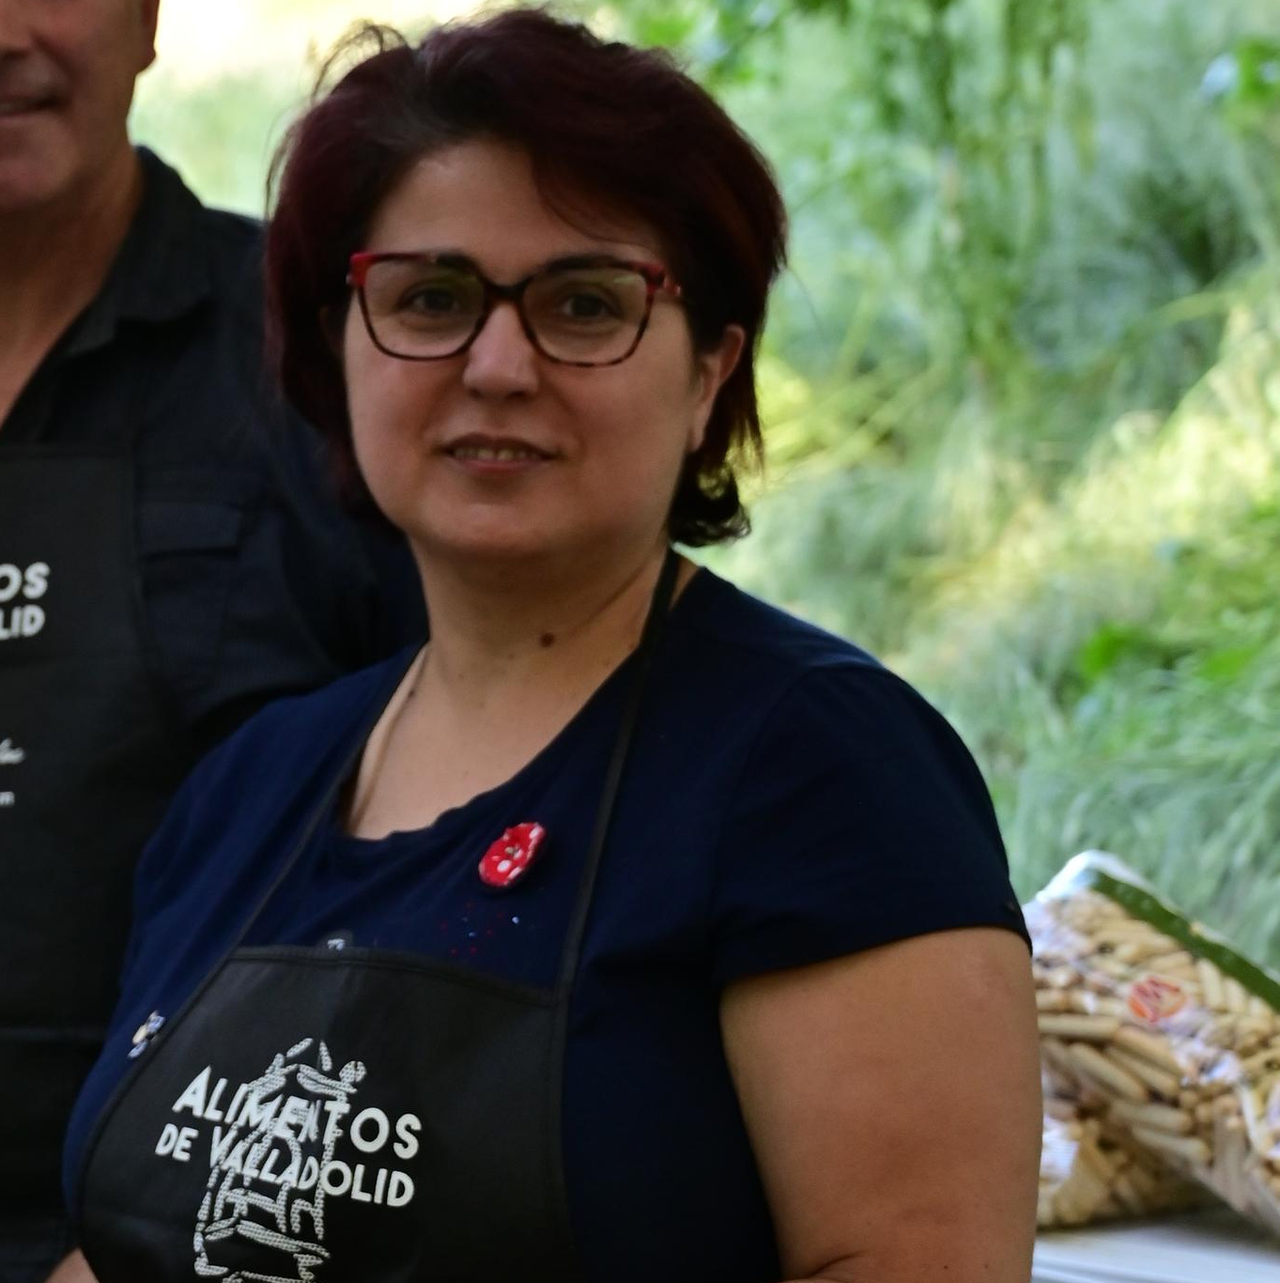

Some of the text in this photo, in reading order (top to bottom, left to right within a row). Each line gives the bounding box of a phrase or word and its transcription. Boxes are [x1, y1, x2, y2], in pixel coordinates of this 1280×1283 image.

[172, 1065, 422, 1160] ALIMENTOS
[155, 1123, 416, 1208] DE VALLADOLID
